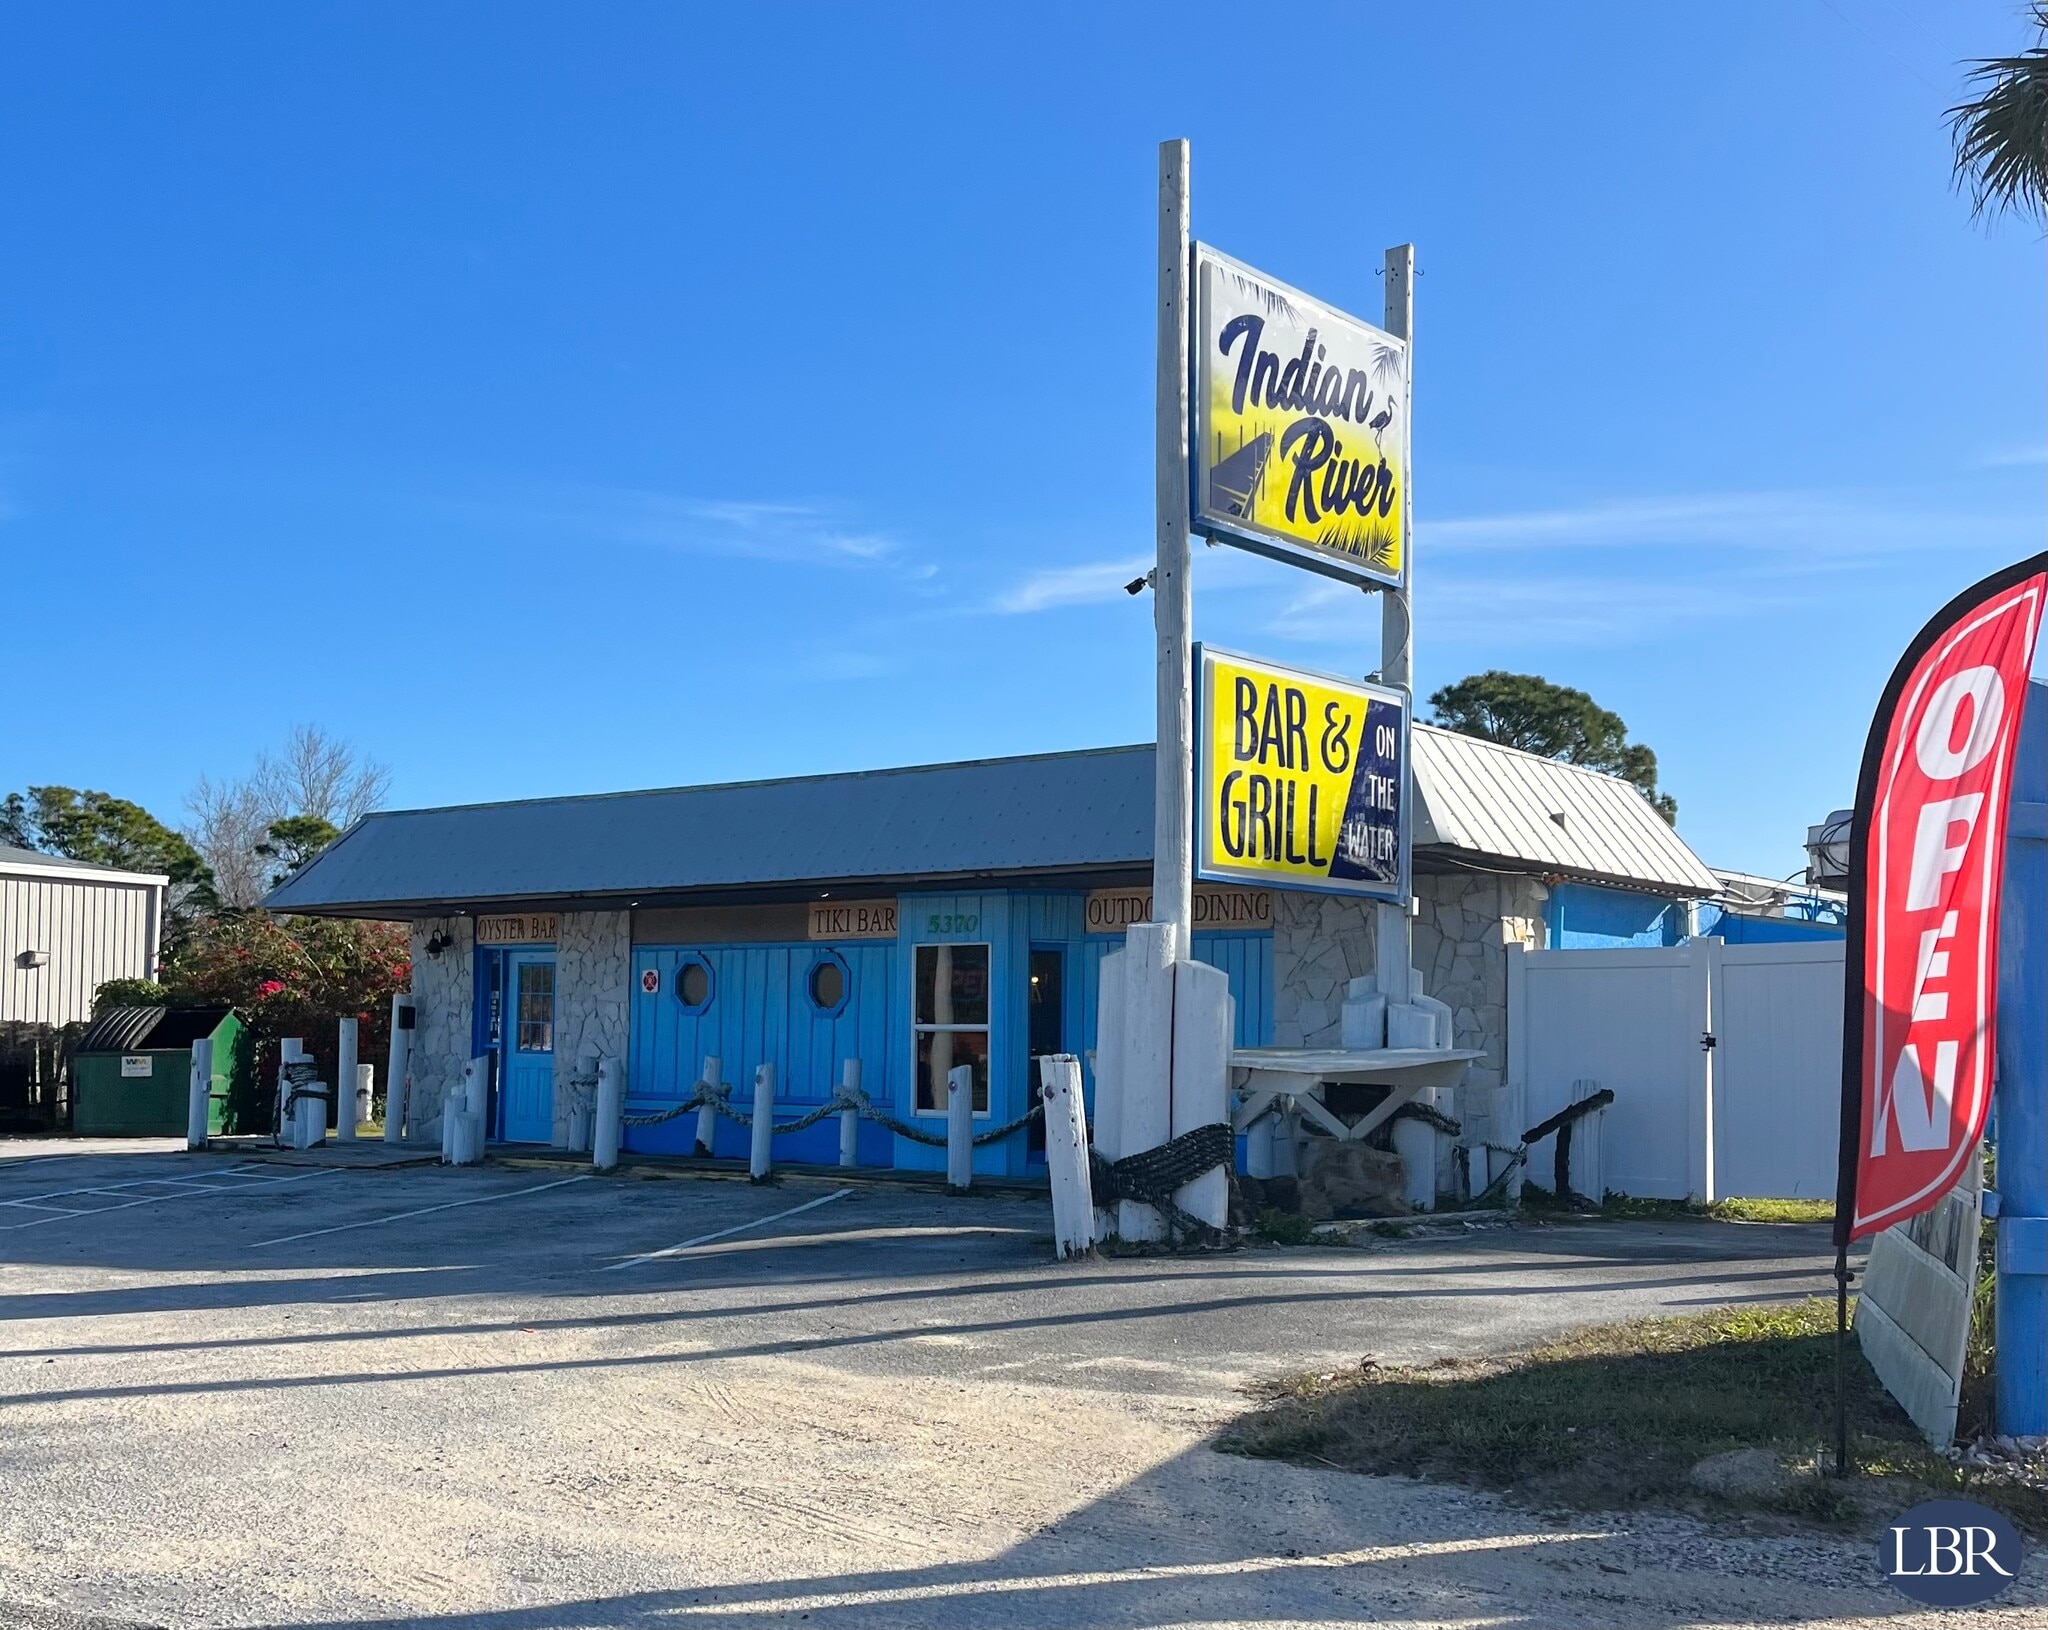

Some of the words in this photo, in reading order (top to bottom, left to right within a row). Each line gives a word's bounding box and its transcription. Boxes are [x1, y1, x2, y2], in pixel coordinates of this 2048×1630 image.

[1218, 314, 1373, 424] Indian
[1279, 416, 1396, 525] River
[1234, 676, 1309, 772] BAR
[1320, 701, 1351, 774] &
[1376, 724, 1395, 761] ON
[1368, 774, 1395, 811] THE
[1220, 769, 1328, 867] GRILL
[1347, 823, 1394, 861] WATER
[815, 908, 850, 933] TIKI
[857, 907, 896, 932] BAR
[1088, 896, 1153, 925] OUTDO
[1194, 893, 1270, 922] DINING
[1870, 664, 2005, 1158] OPEN
[478, 917, 525, 941] OYSTER
[531, 916, 557, 939] BAR
